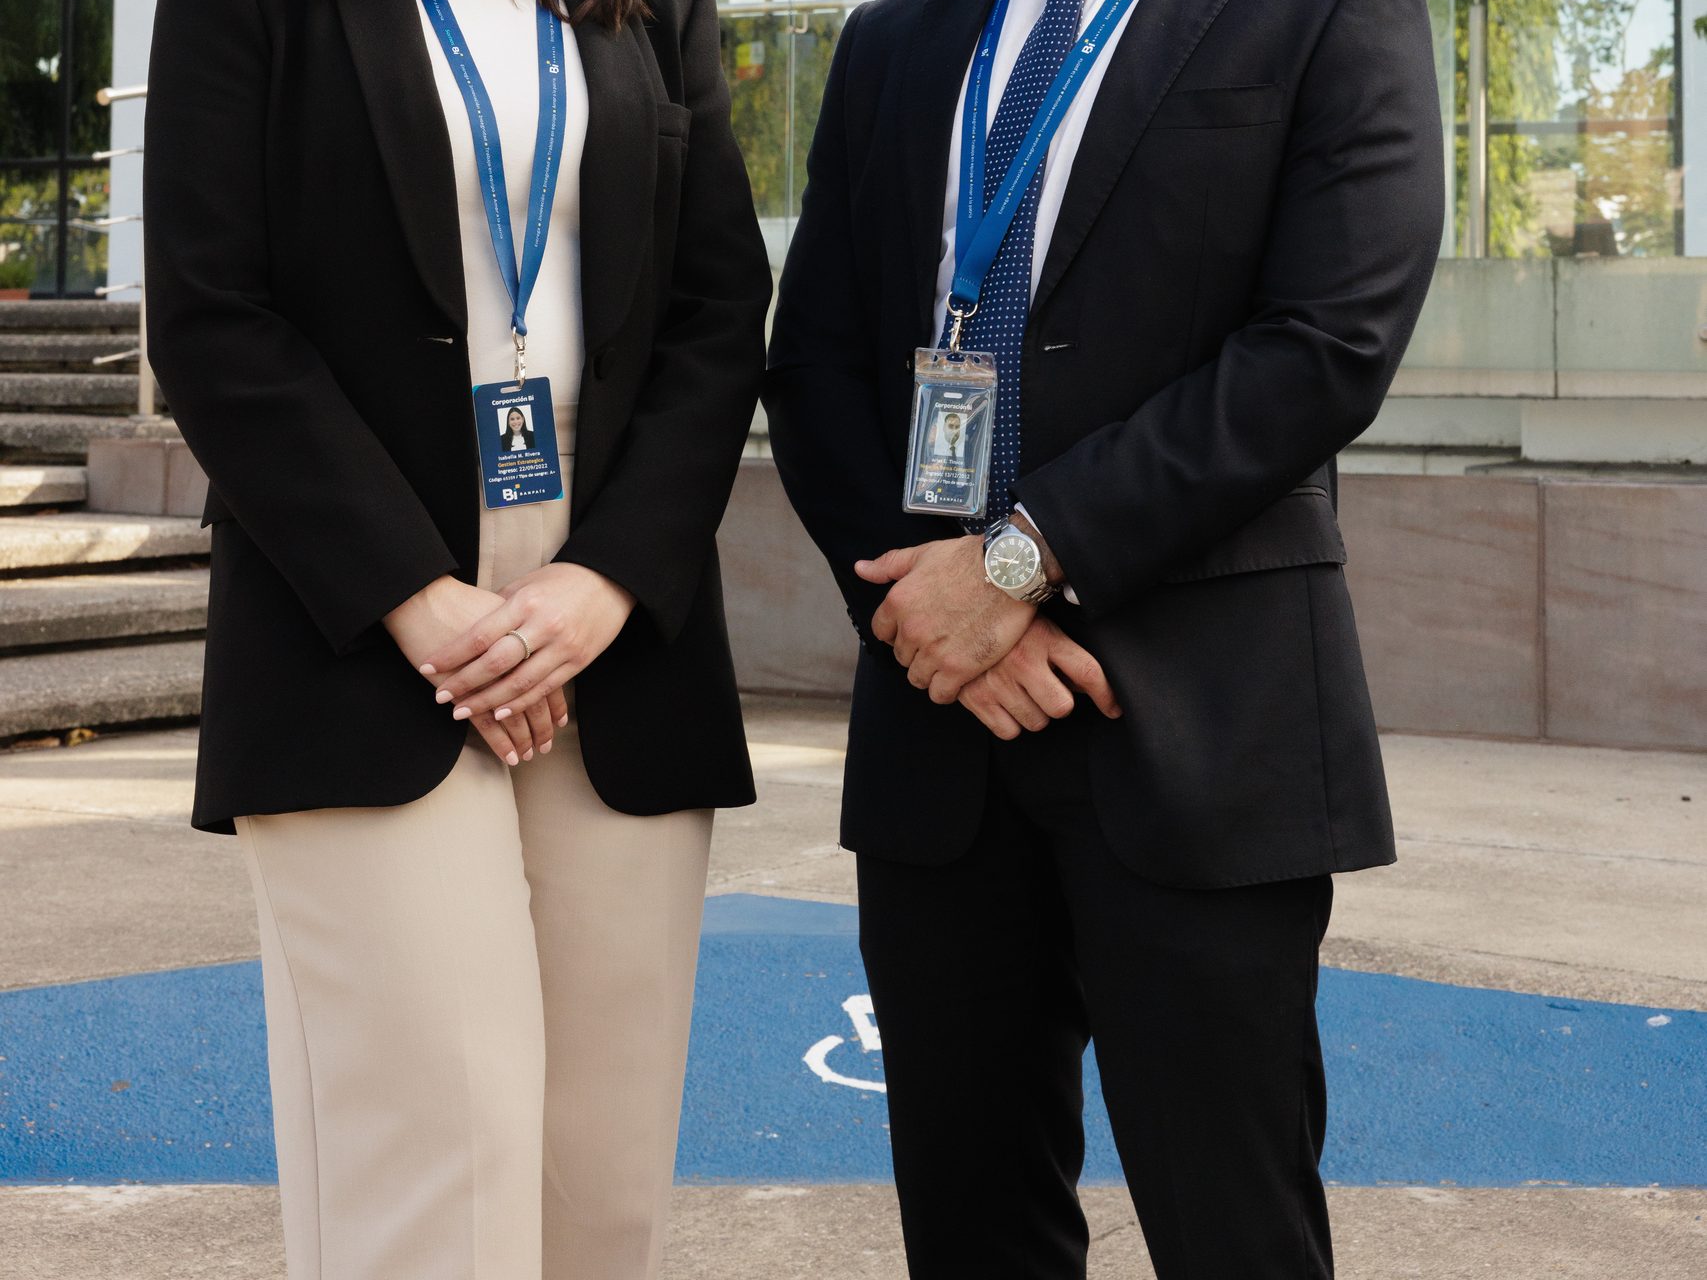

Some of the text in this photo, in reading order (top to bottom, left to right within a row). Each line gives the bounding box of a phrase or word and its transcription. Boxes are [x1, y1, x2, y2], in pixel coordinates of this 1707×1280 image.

[491, 395, 528, 406] Corporación
[502, 487, 519, 501] Bi
[925, 489, 939, 504] Bi
